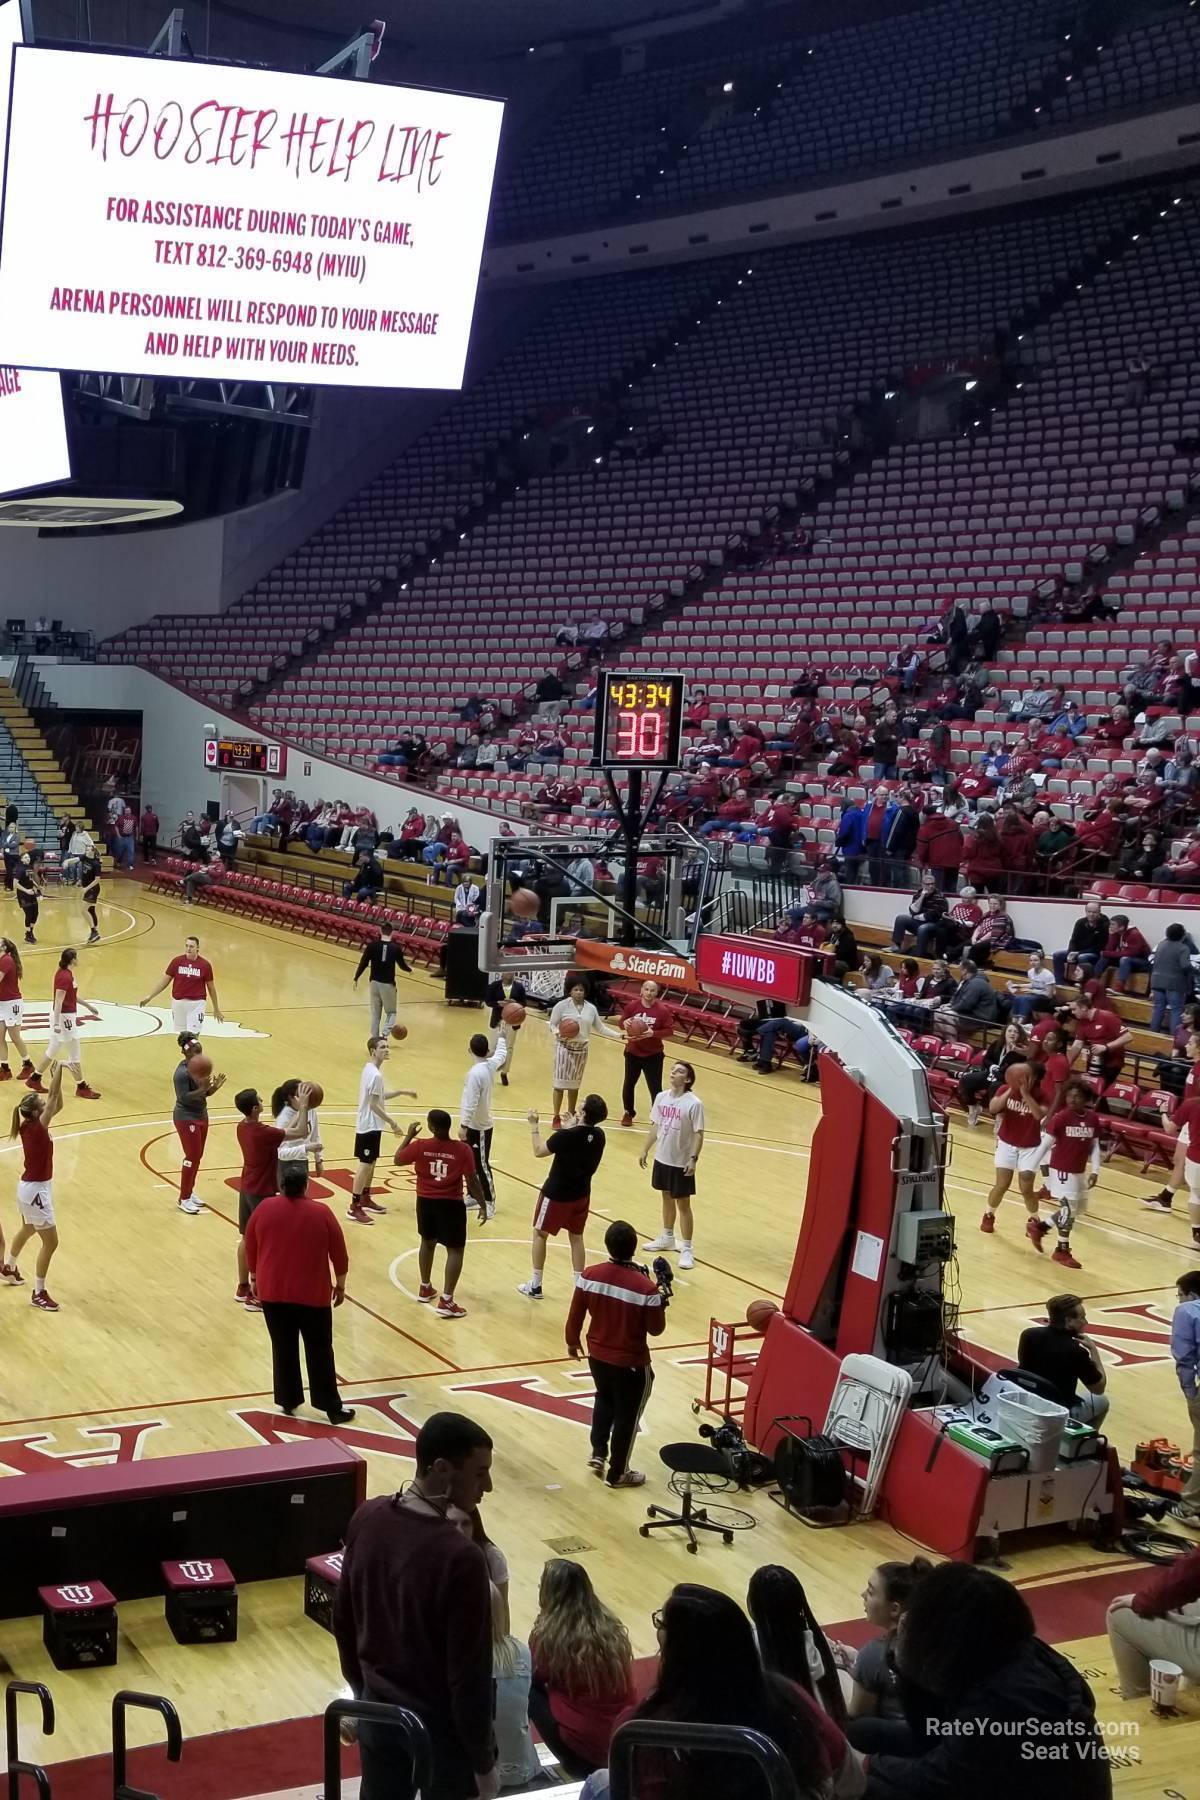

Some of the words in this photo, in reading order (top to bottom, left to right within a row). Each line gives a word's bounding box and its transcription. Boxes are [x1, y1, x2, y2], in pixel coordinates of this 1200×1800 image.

[83, 93, 278, 169] HOOSIER
[280, 112, 375, 182] HELP
[377, 123, 452, 194] LINE
[106, 197, 139, 223] FOR
[142, 200, 243, 232] ASSISTANCE
[247, 209, 306, 237] DURING
[310, 214, 371, 242] TODAY'S
[373, 221, 414, 249] GAME,
[154, 239, 194, 266] TEXT
[196, 243, 312, 275] 812-369-6948
[316, 252, 366, 284] (MYIU)
[49, 287, 105, 314] ARENA
[109, 291, 203, 320] PERSONNEL
[206, 299, 243, 323] WILL
[246, 301, 317, 328] RESPOND
[320, 306, 338, 328] TO
[341, 307, 377, 332] YOUR
[379, 309, 439, 336] MESSAGE
[144, 332, 178, 356] AND
[183, 334, 222, 359] HELP
[226, 337, 265, 361] WITH
[269, 340, 307, 364] YOUR
[311, 342, 360, 367] NEEDS.
[611, 684, 671, 708] 43:34
[617, 713, 661, 755] 30
[722, 950, 775, 984] #IUWBB
[179, 1561, 213, 1581] IU
[57, 1584, 94, 1604] IU
